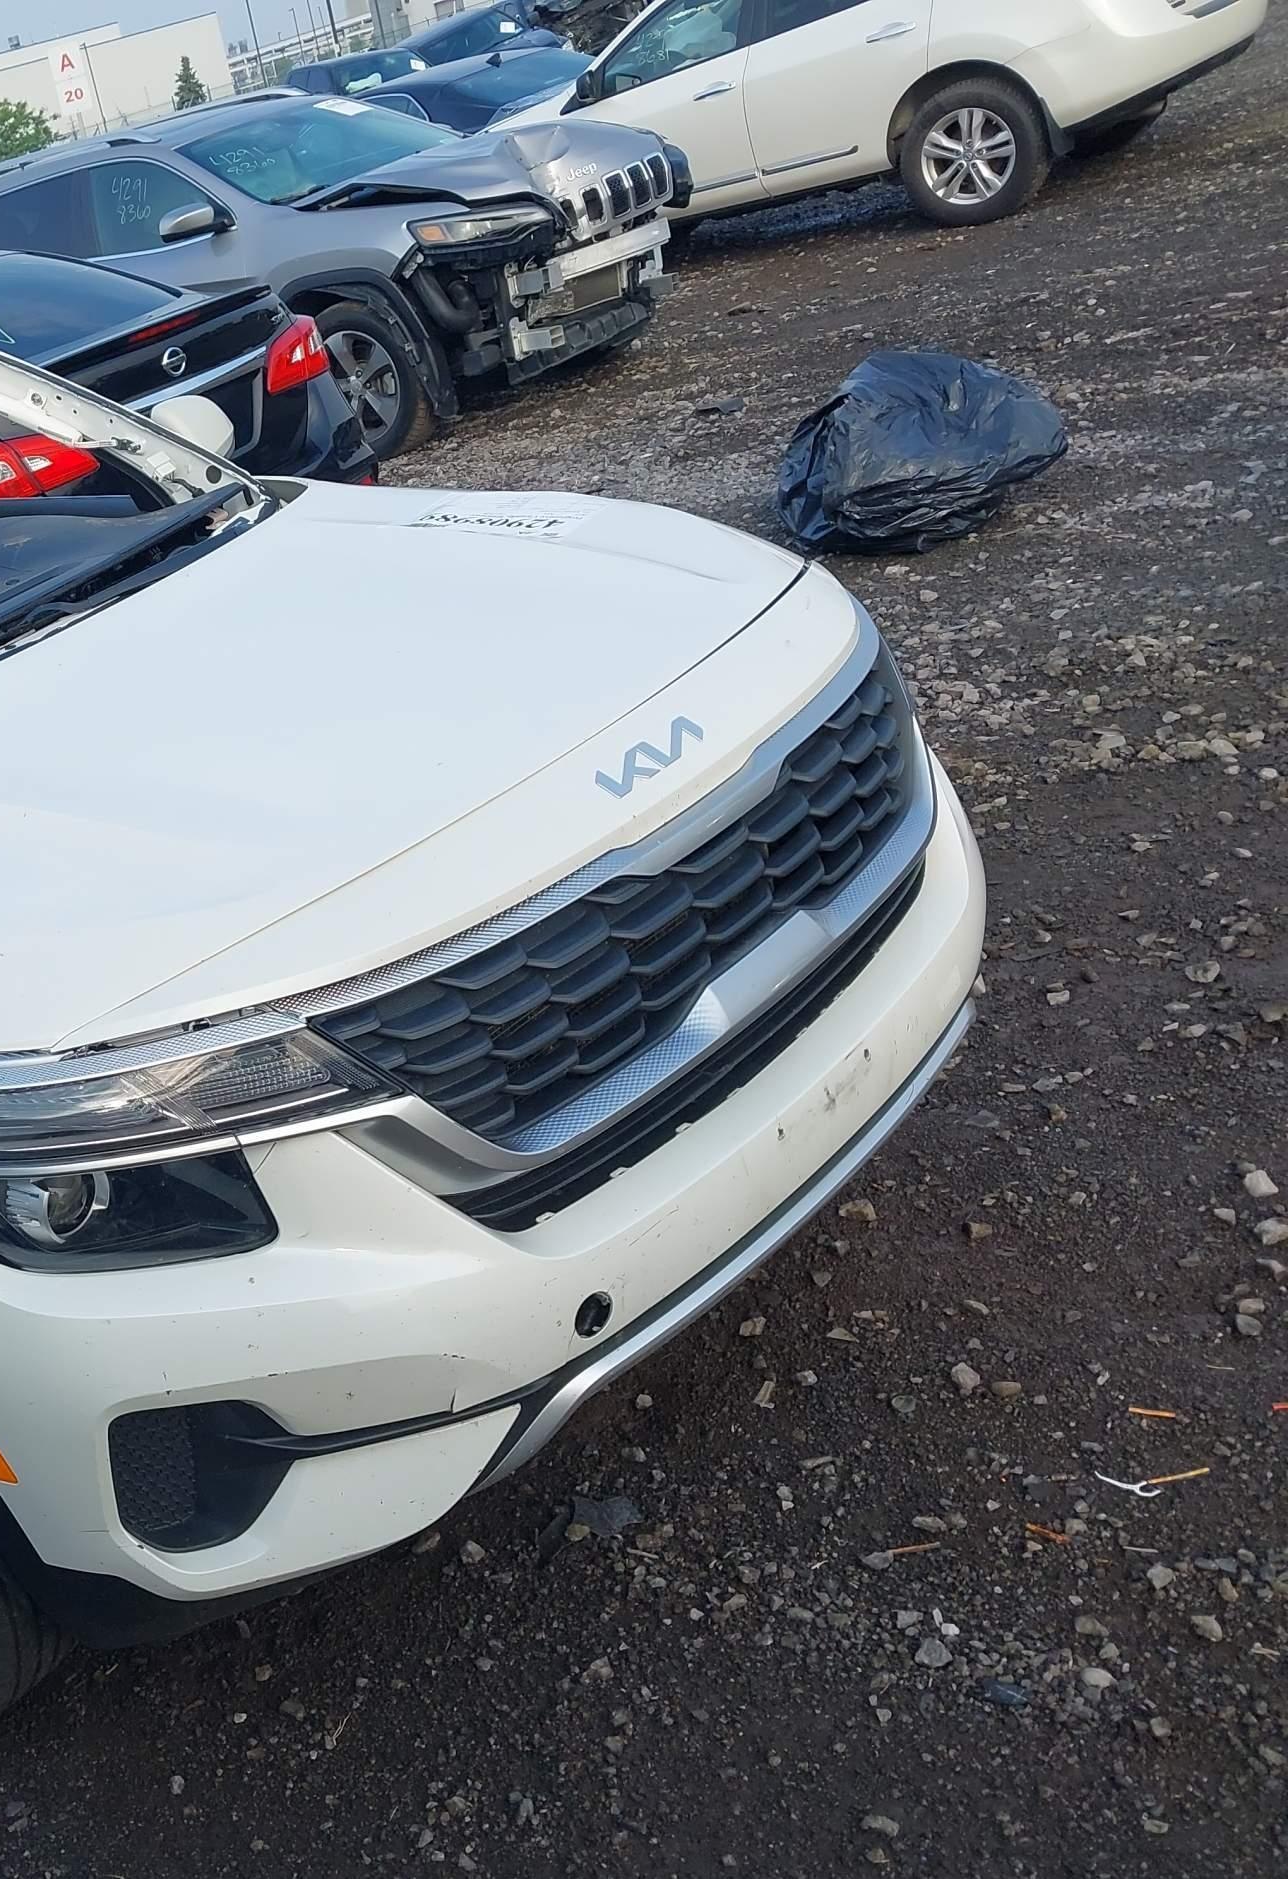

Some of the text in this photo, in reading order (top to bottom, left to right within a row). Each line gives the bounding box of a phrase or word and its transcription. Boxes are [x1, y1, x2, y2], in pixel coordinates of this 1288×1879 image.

[60, 53, 75, 72] A
[64, 87, 84, 103] 20
[567, 163, 597, 181] Jeep
[112, 177, 148, 201] 4291
[117, 204, 151, 224] 8360
